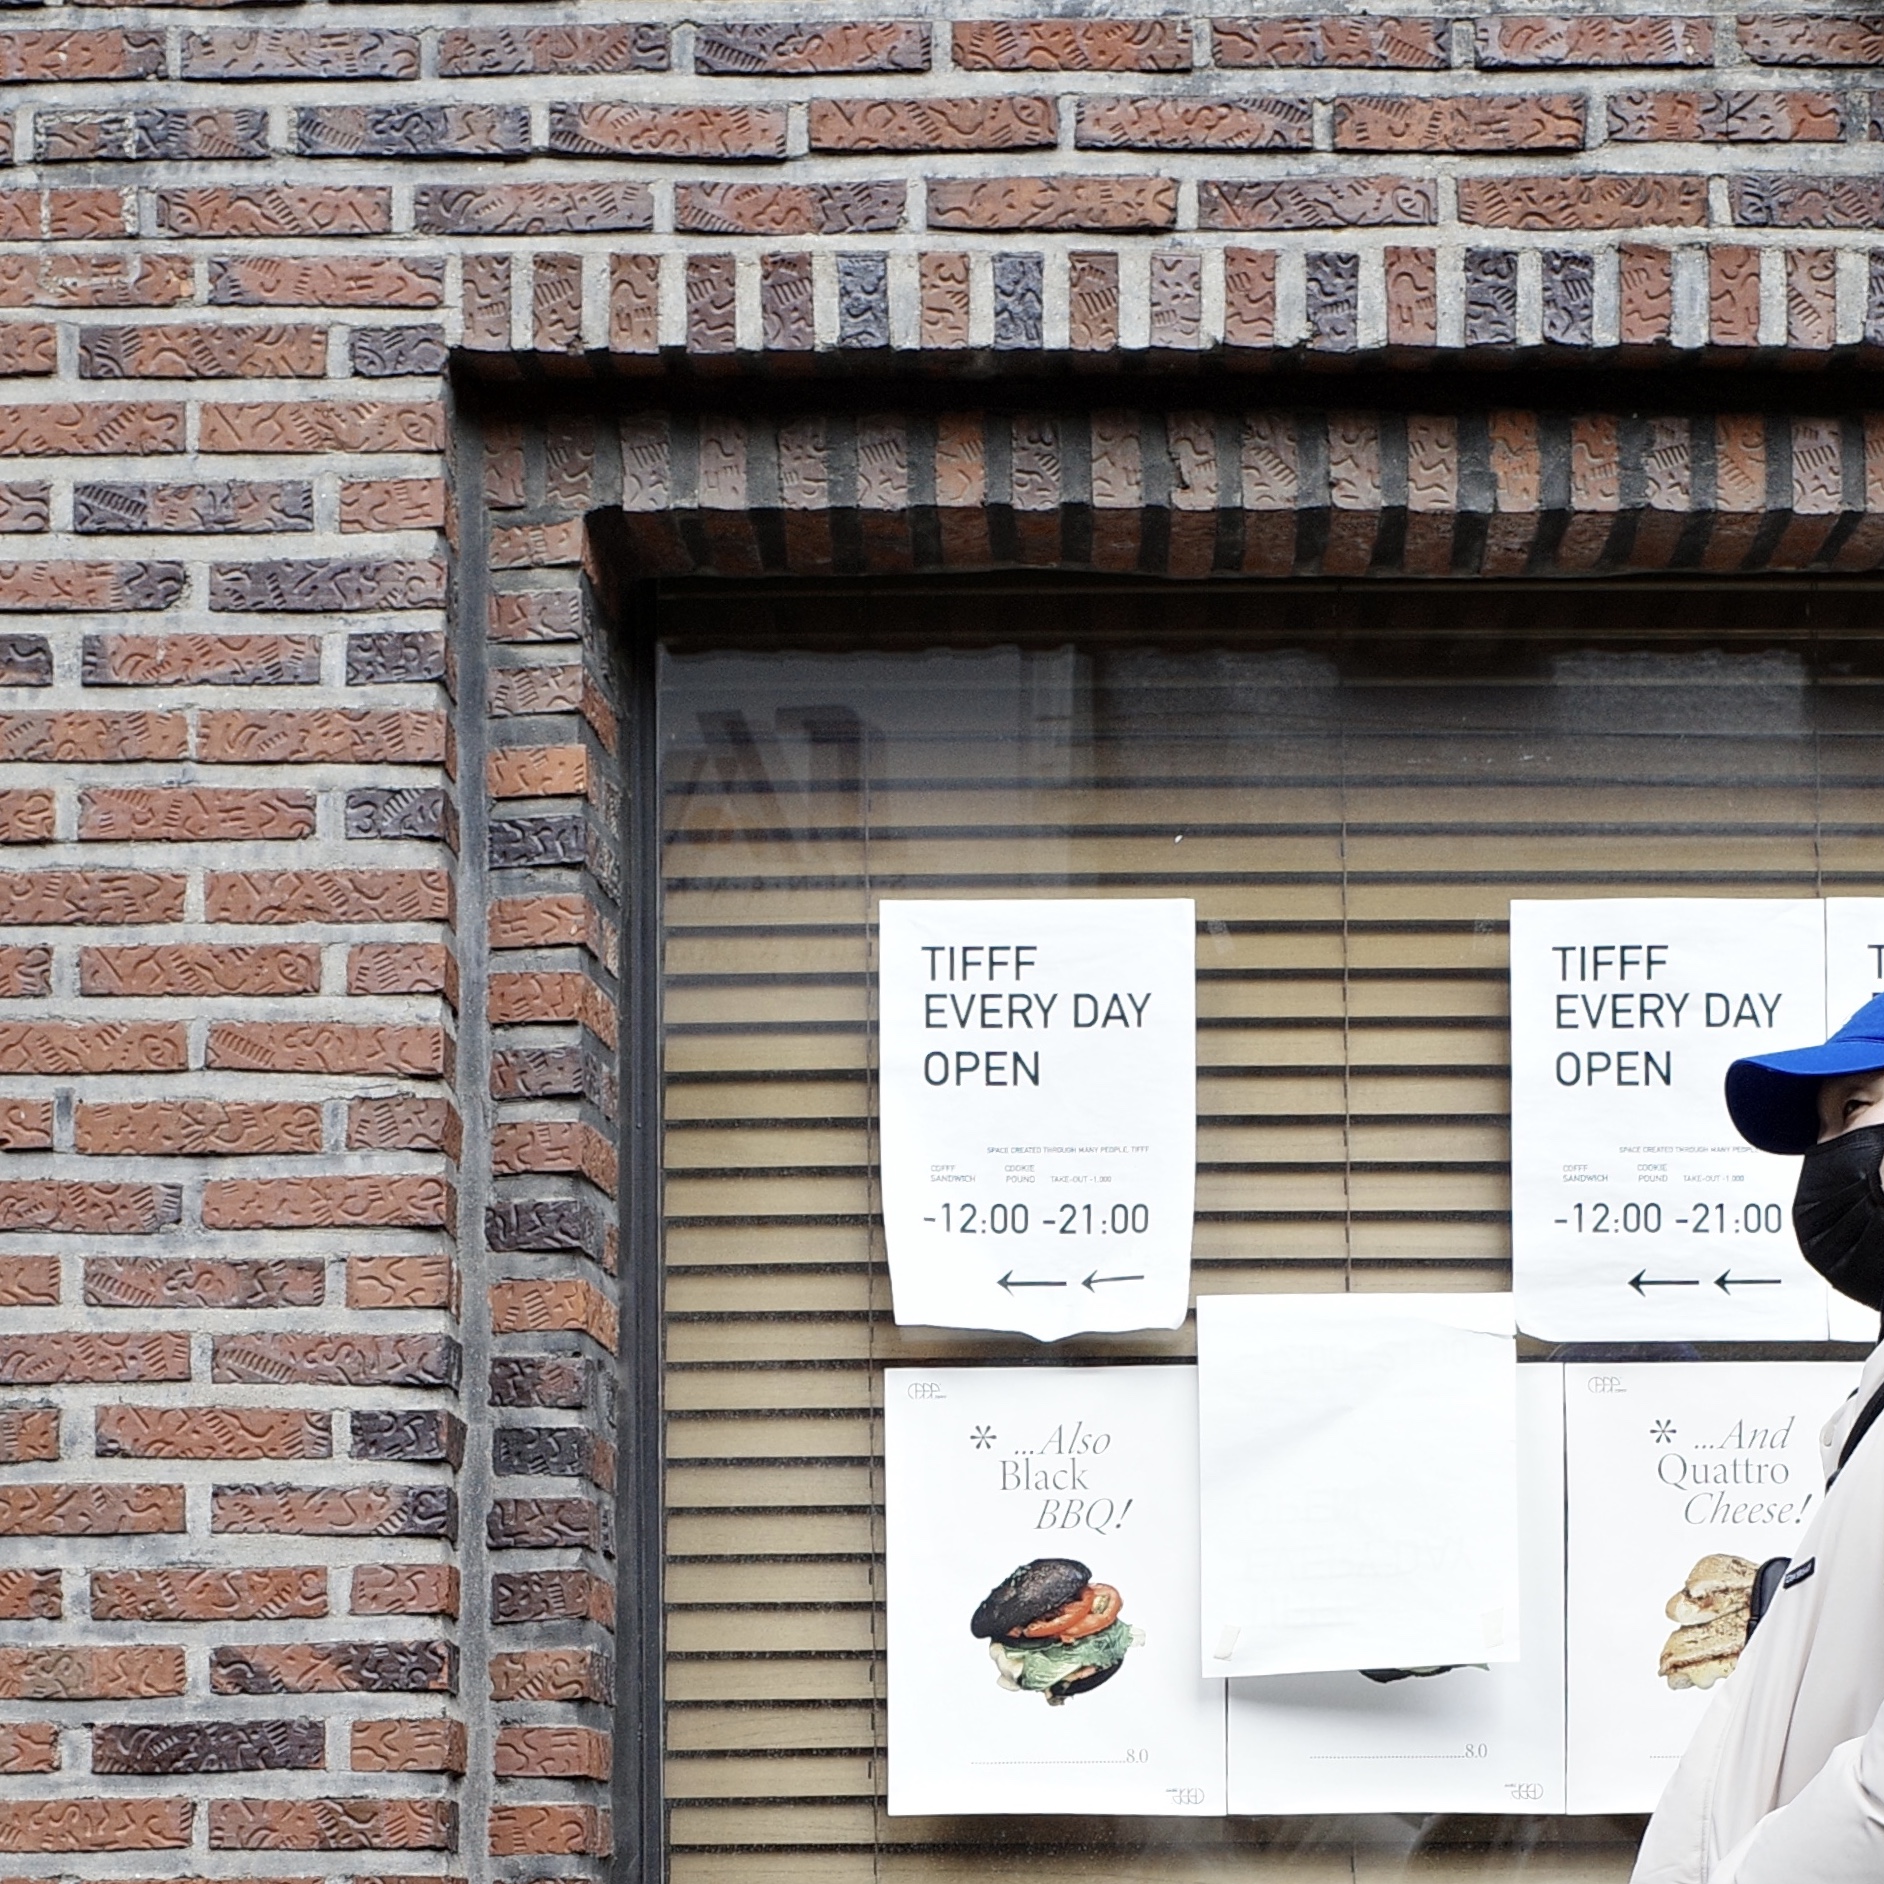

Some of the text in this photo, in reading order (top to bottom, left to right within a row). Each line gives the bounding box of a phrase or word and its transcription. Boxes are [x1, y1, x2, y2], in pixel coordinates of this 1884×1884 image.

[922, 946, 1037, 981] TIFFF
[1552, 945, 1668, 981] TIFFF
[925, 993, 1151, 1029] EVERY DAY
[1556, 993, 1782, 1029] EVERY DAY
[925, 1051, 1039, 1086] OPEN
[1556, 1051, 1670, 1086] OPEN
[987, 1146, 1008, 1154] SPACE
[1011, 1146, 1041, 1154] CREATED
[1043, 1146, 1076, 1154] THROUGH
[1079, 1146, 1098, 1154] MANY
[1637, 1163, 1667, 1171] COOKIE
[931, 1175, 976, 1183] SANDWICH
[1006, 1175, 1035, 1183] POUND
[1000, 1458, 1089, 1491] Black
[1657, 1453, 1789, 1491] Quattro
[1036, 1498, 1133, 1535] BBQ!
[1684, 1493, 1813, 1526] Cheese!
